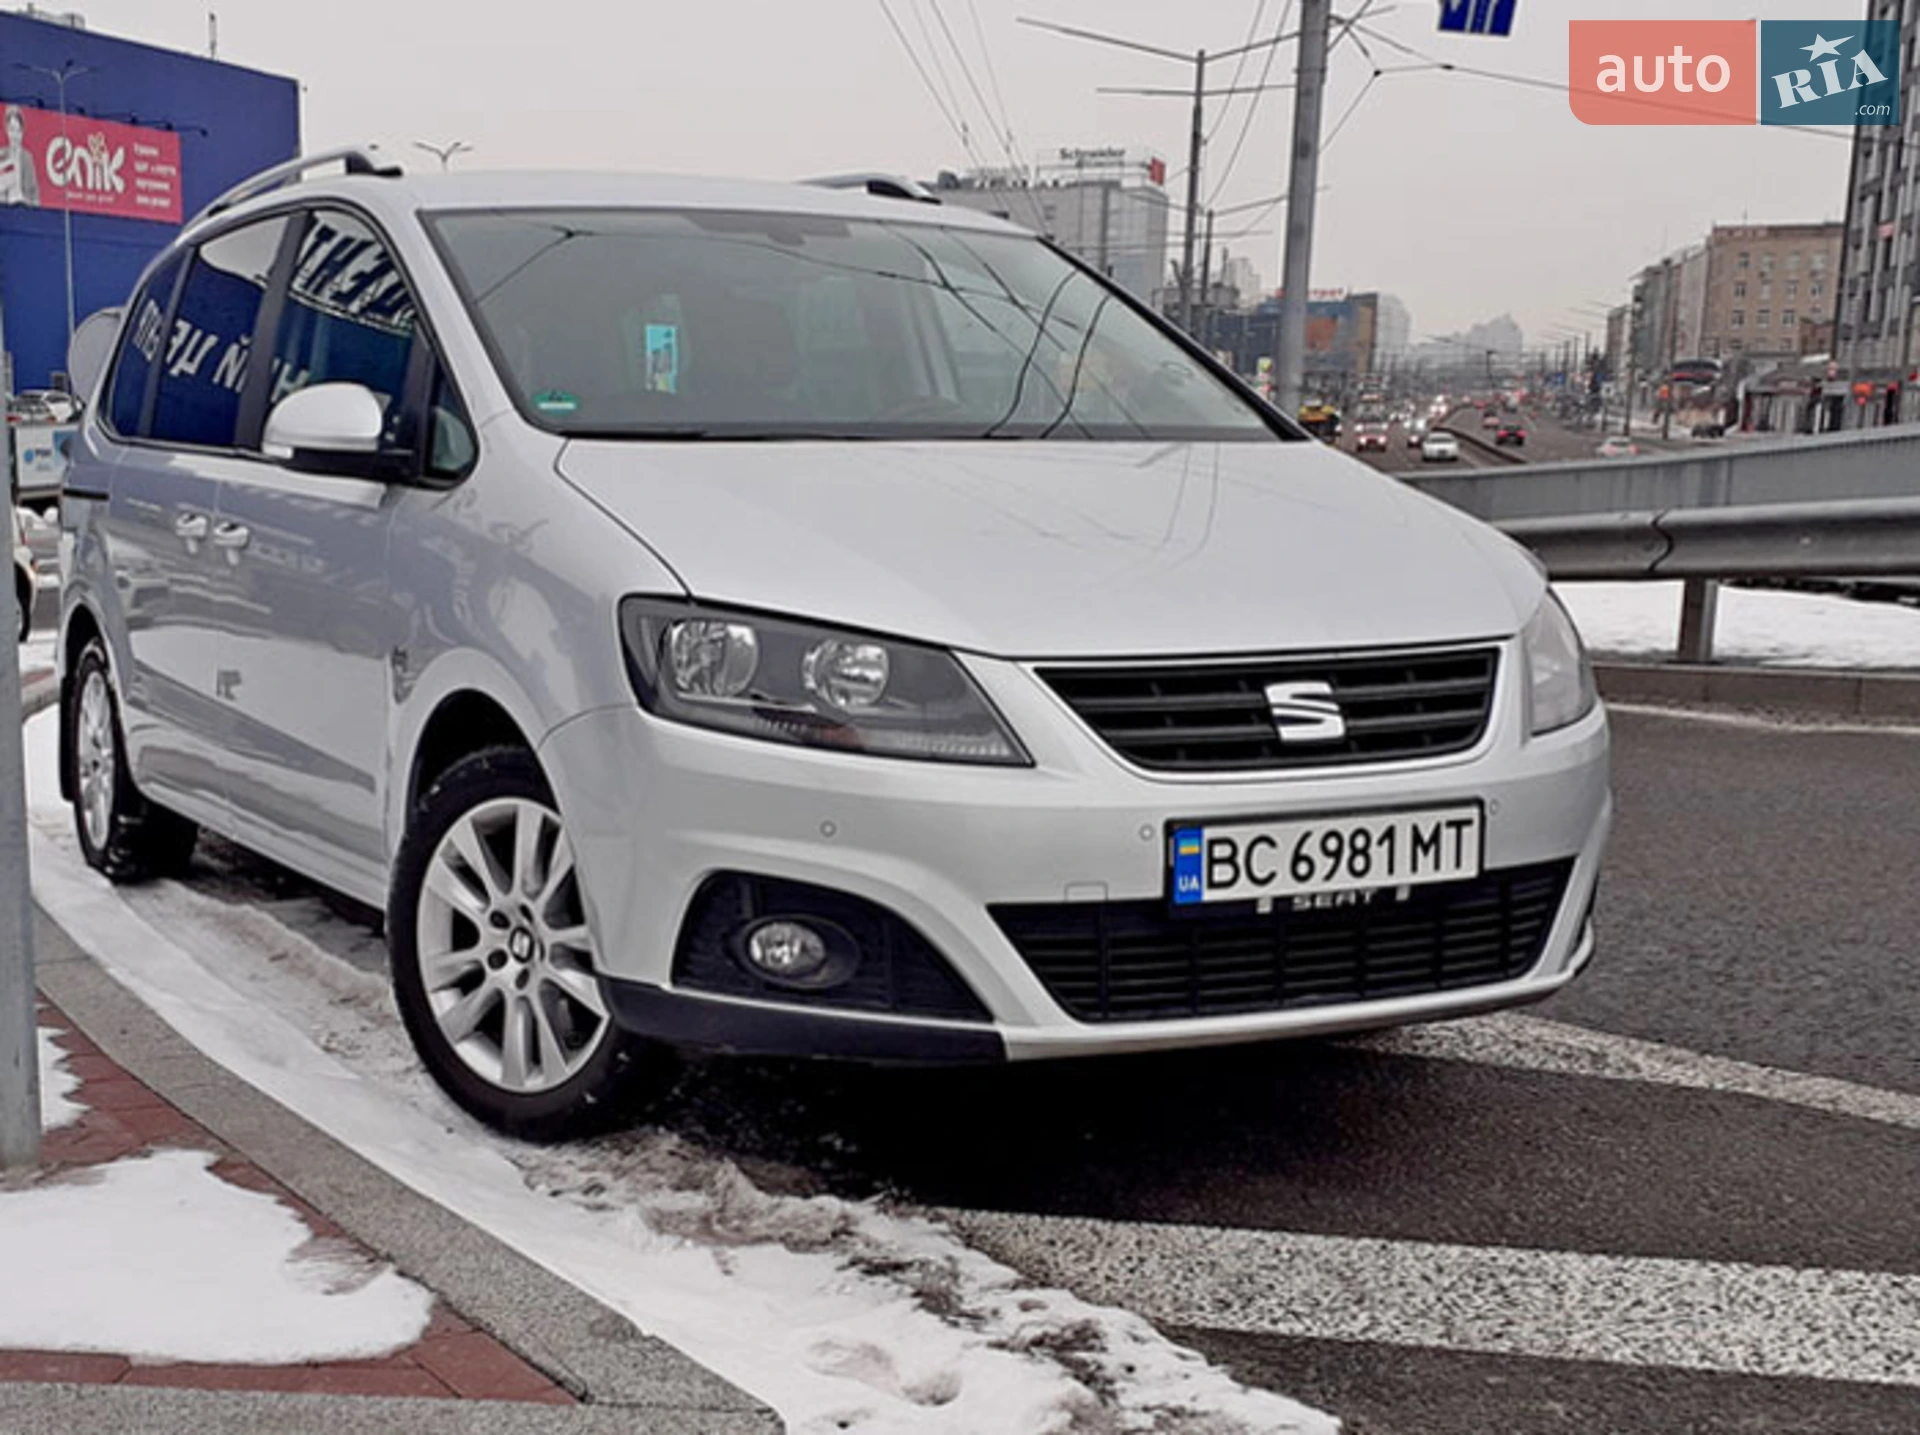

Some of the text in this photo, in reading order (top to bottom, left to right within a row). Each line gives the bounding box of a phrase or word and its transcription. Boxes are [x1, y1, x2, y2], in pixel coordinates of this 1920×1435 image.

[1206, 819, 1473, 890] BC 6981 MT
[1179, 875, 1200, 892] UA
